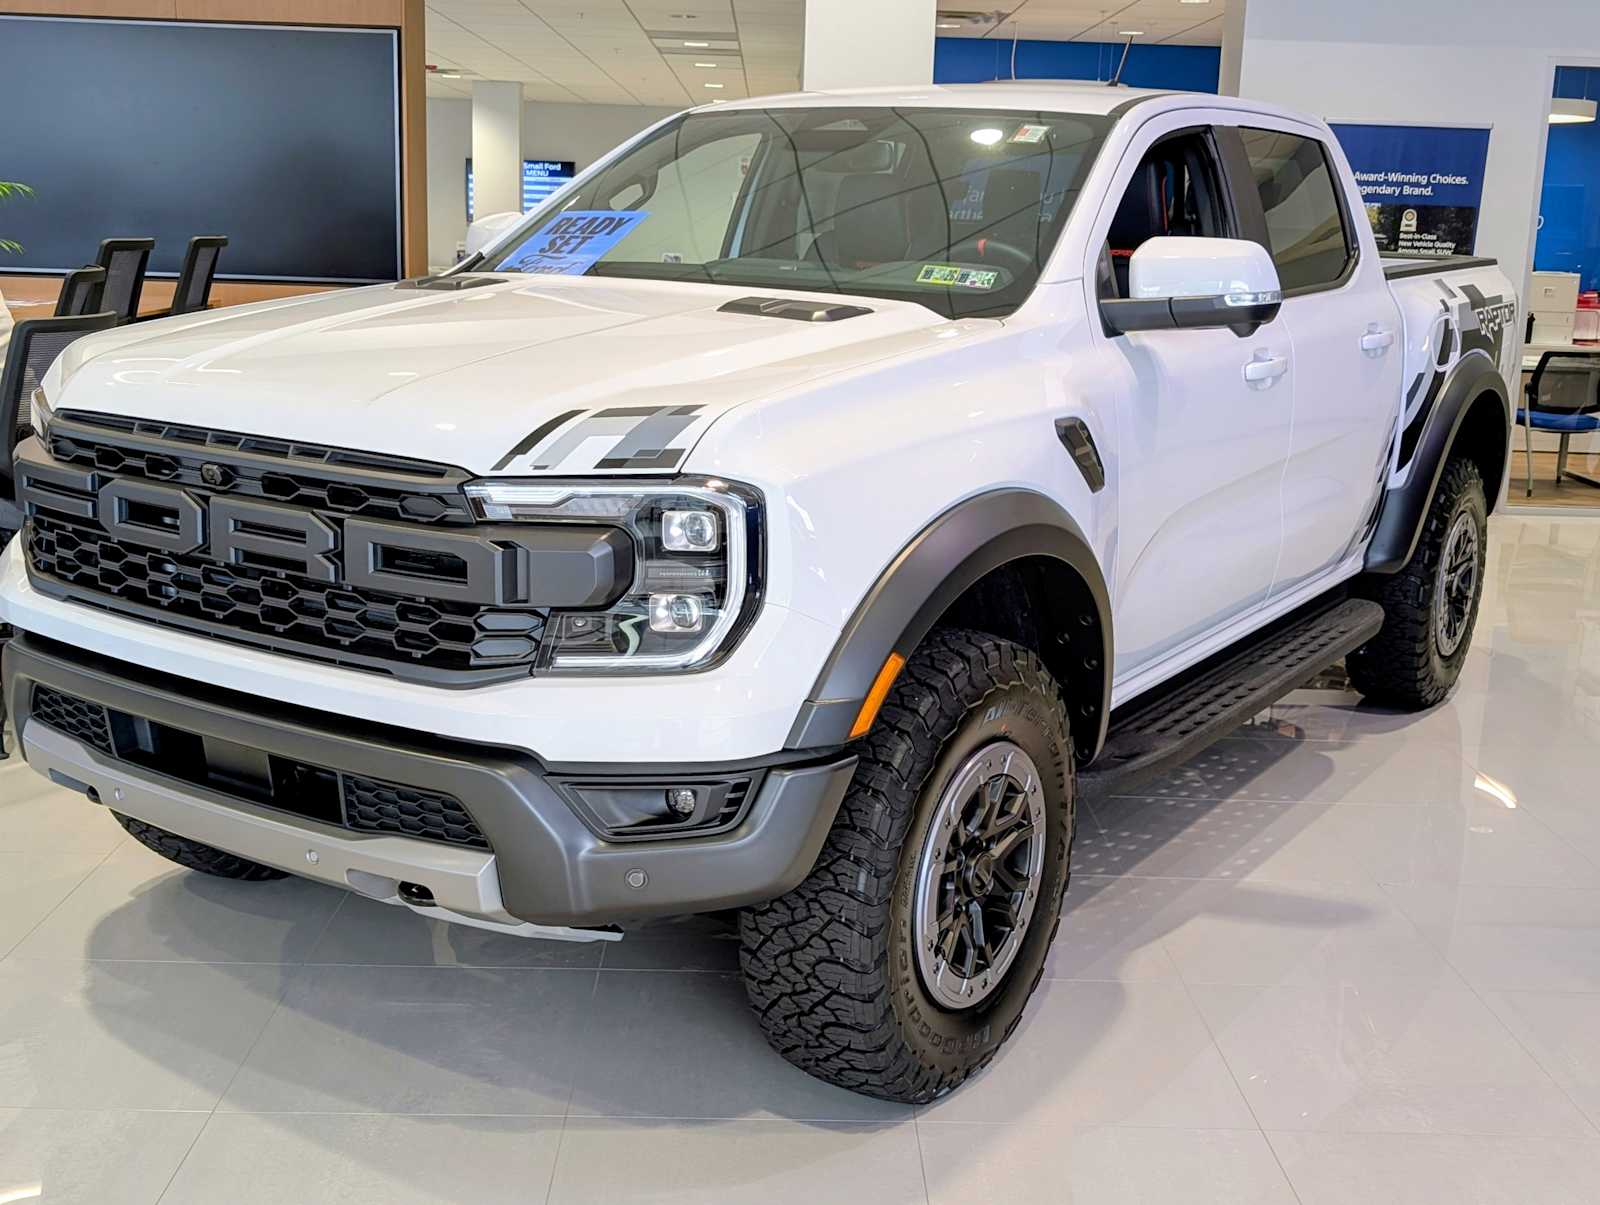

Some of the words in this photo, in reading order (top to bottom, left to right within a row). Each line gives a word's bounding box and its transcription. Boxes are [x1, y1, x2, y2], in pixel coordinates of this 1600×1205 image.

[544, 163, 562, 171] Ford
[1354, 172, 1428, 184] Award-Winning
[1429, 174, 1469, 185] Choices.
[1360, 185, 1401, 196] gendary
[1402, 186, 1434, 196] Brand.
[544, 217, 634, 235] READY
[538, 235, 594, 254] SET
[1475, 302, 1516, 344] RAPTOR
[14, 456, 516, 607] FORD
